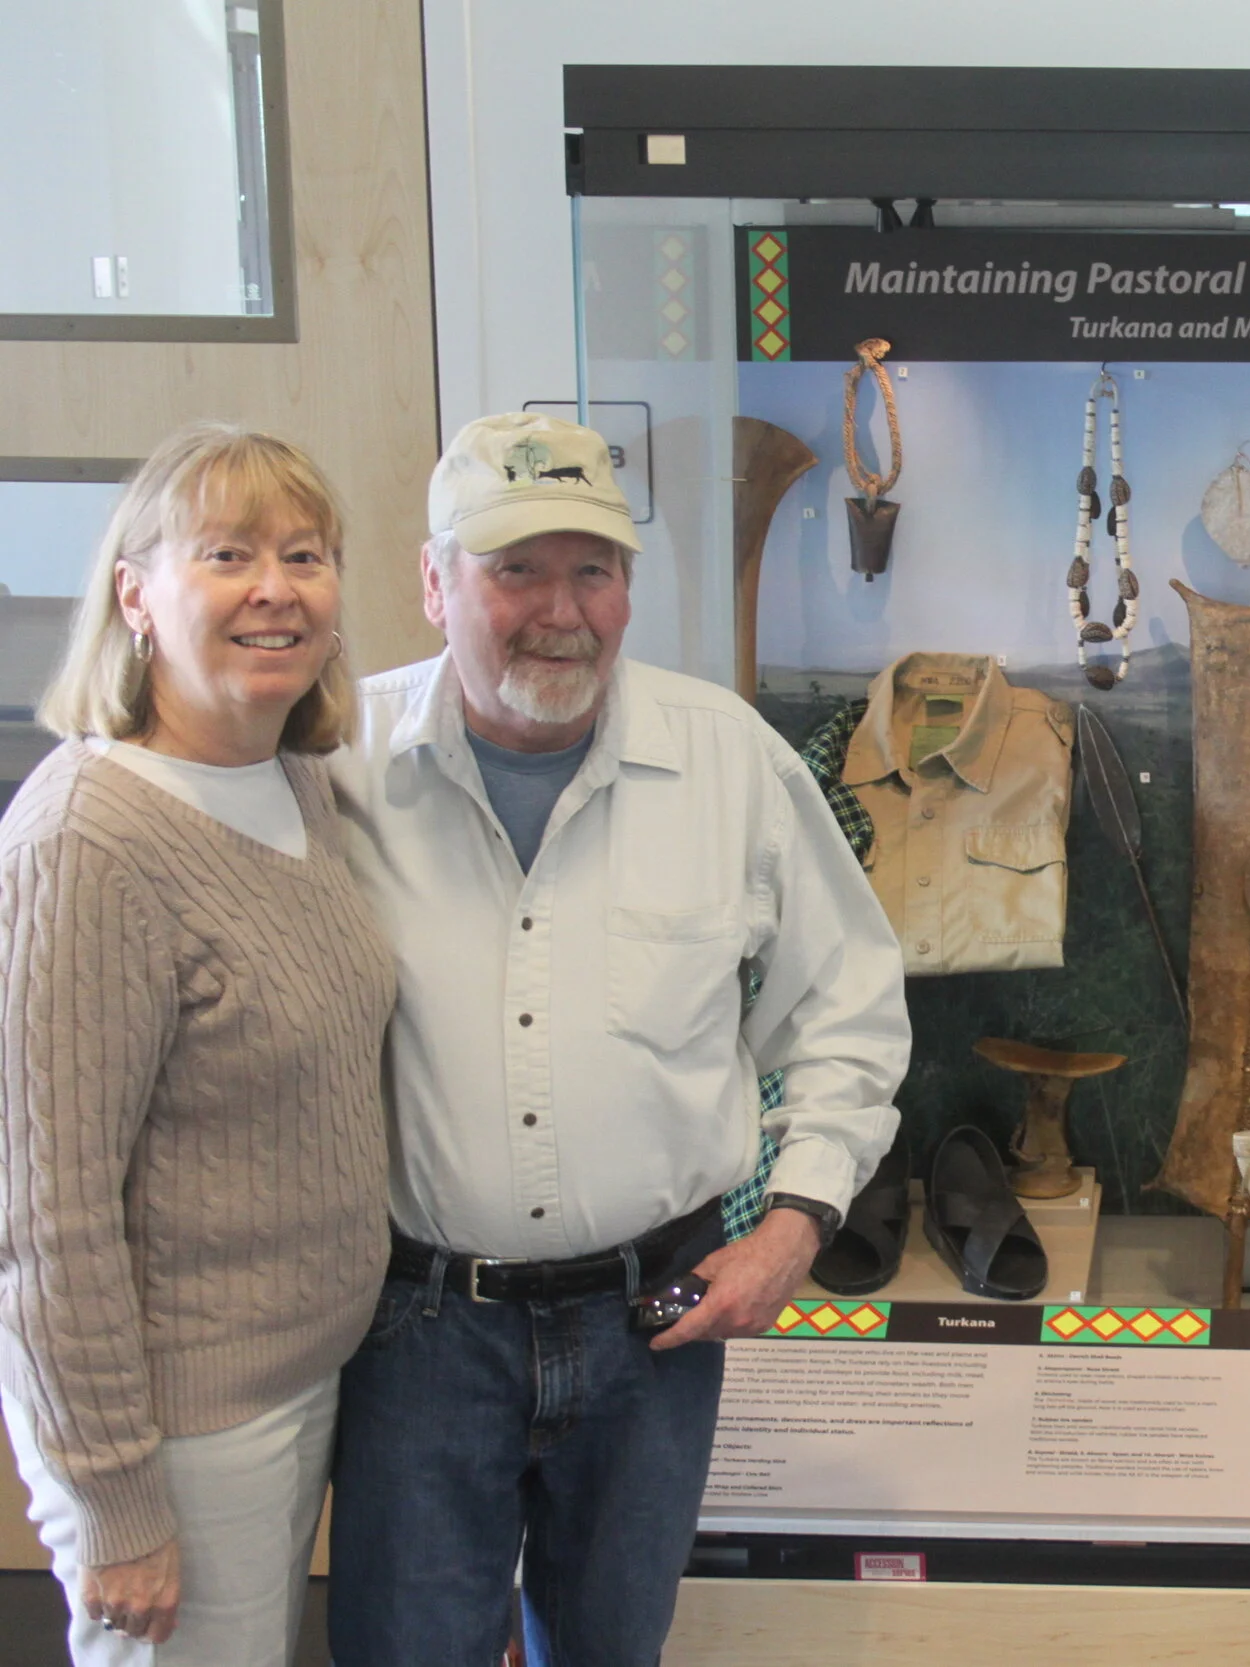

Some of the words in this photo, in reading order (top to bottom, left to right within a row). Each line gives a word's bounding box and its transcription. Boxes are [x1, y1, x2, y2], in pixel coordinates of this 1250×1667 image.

[845, 260, 1077, 301] Maintaining
[1086, 261, 1245, 293] Pastoral
[1070, 315, 1172, 337] Turkana
[1179, 316, 1227, 338] and
[938, 1317, 995, 1327] Turkana
